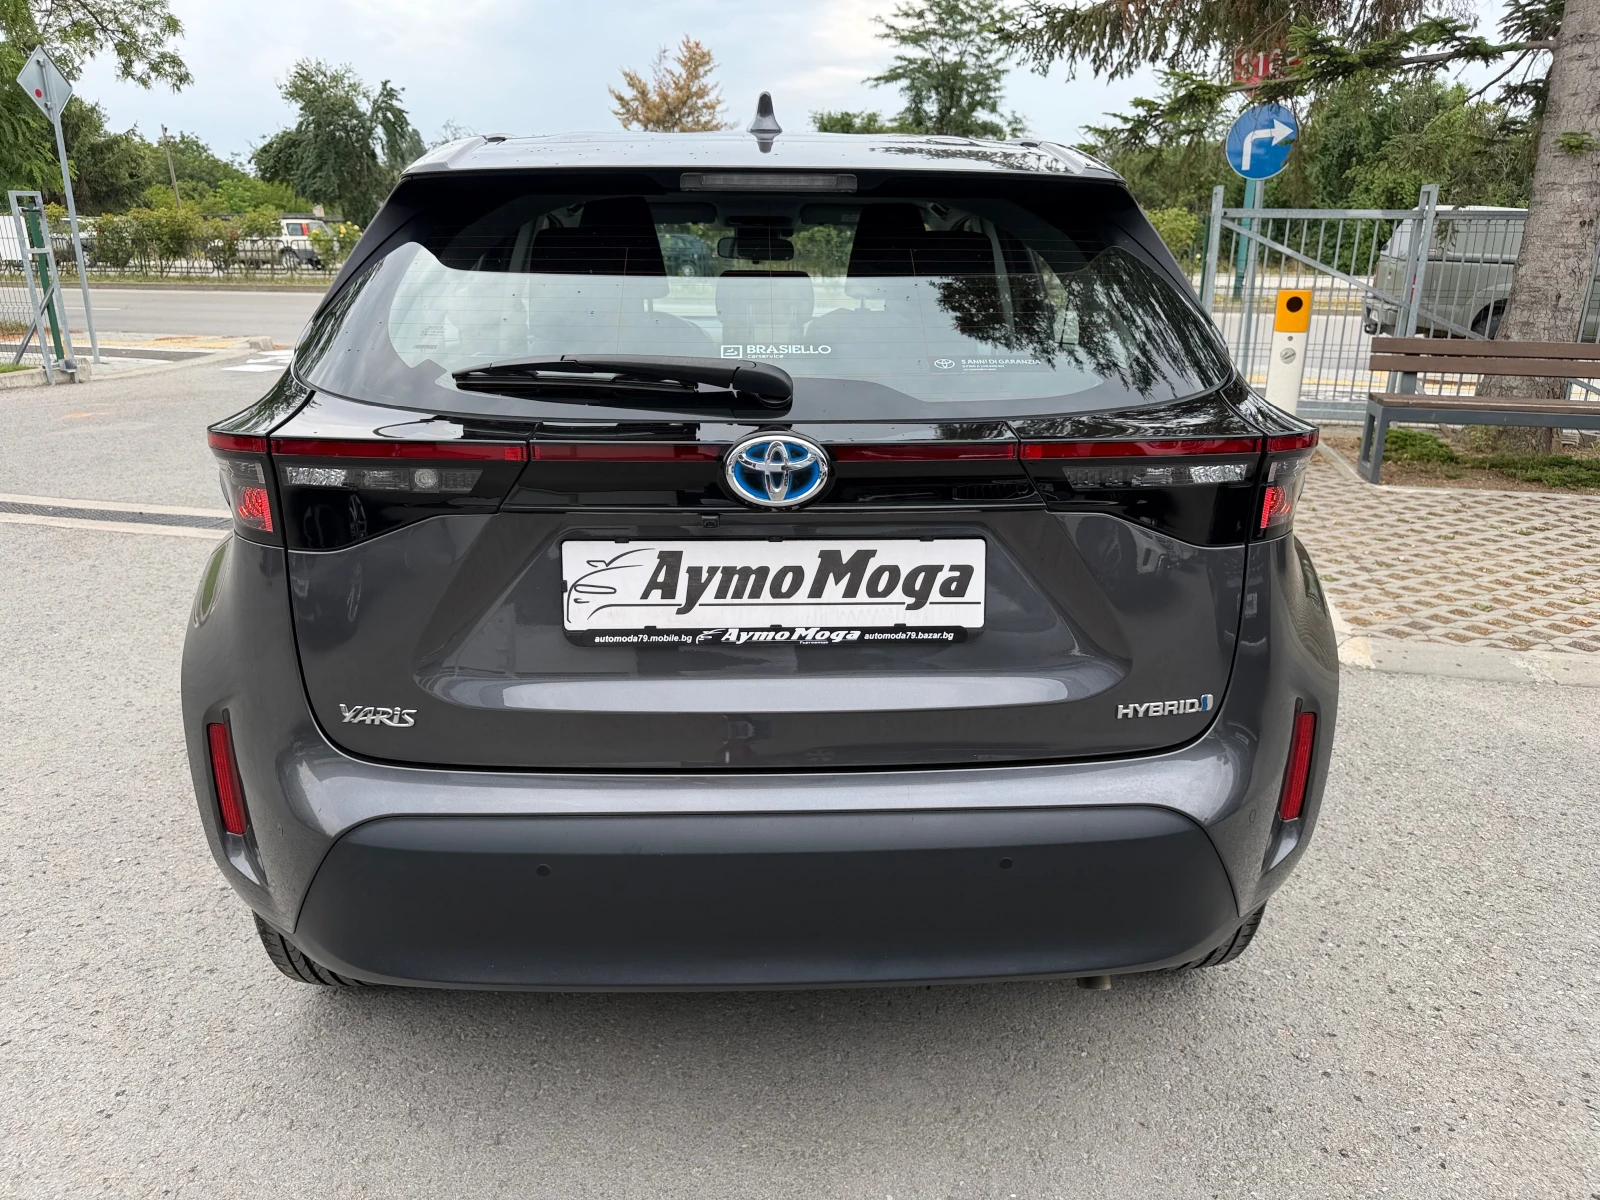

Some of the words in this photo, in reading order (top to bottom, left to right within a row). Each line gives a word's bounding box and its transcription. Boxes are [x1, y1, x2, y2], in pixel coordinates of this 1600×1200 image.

[746, 344, 832, 355] BRASIELLO
[594, 634, 692, 643] automoda79.mobile.bg
[863, 631, 954, 640] automoda79.bazar.bg
[1117, 698, 1200, 719] HYBRID
